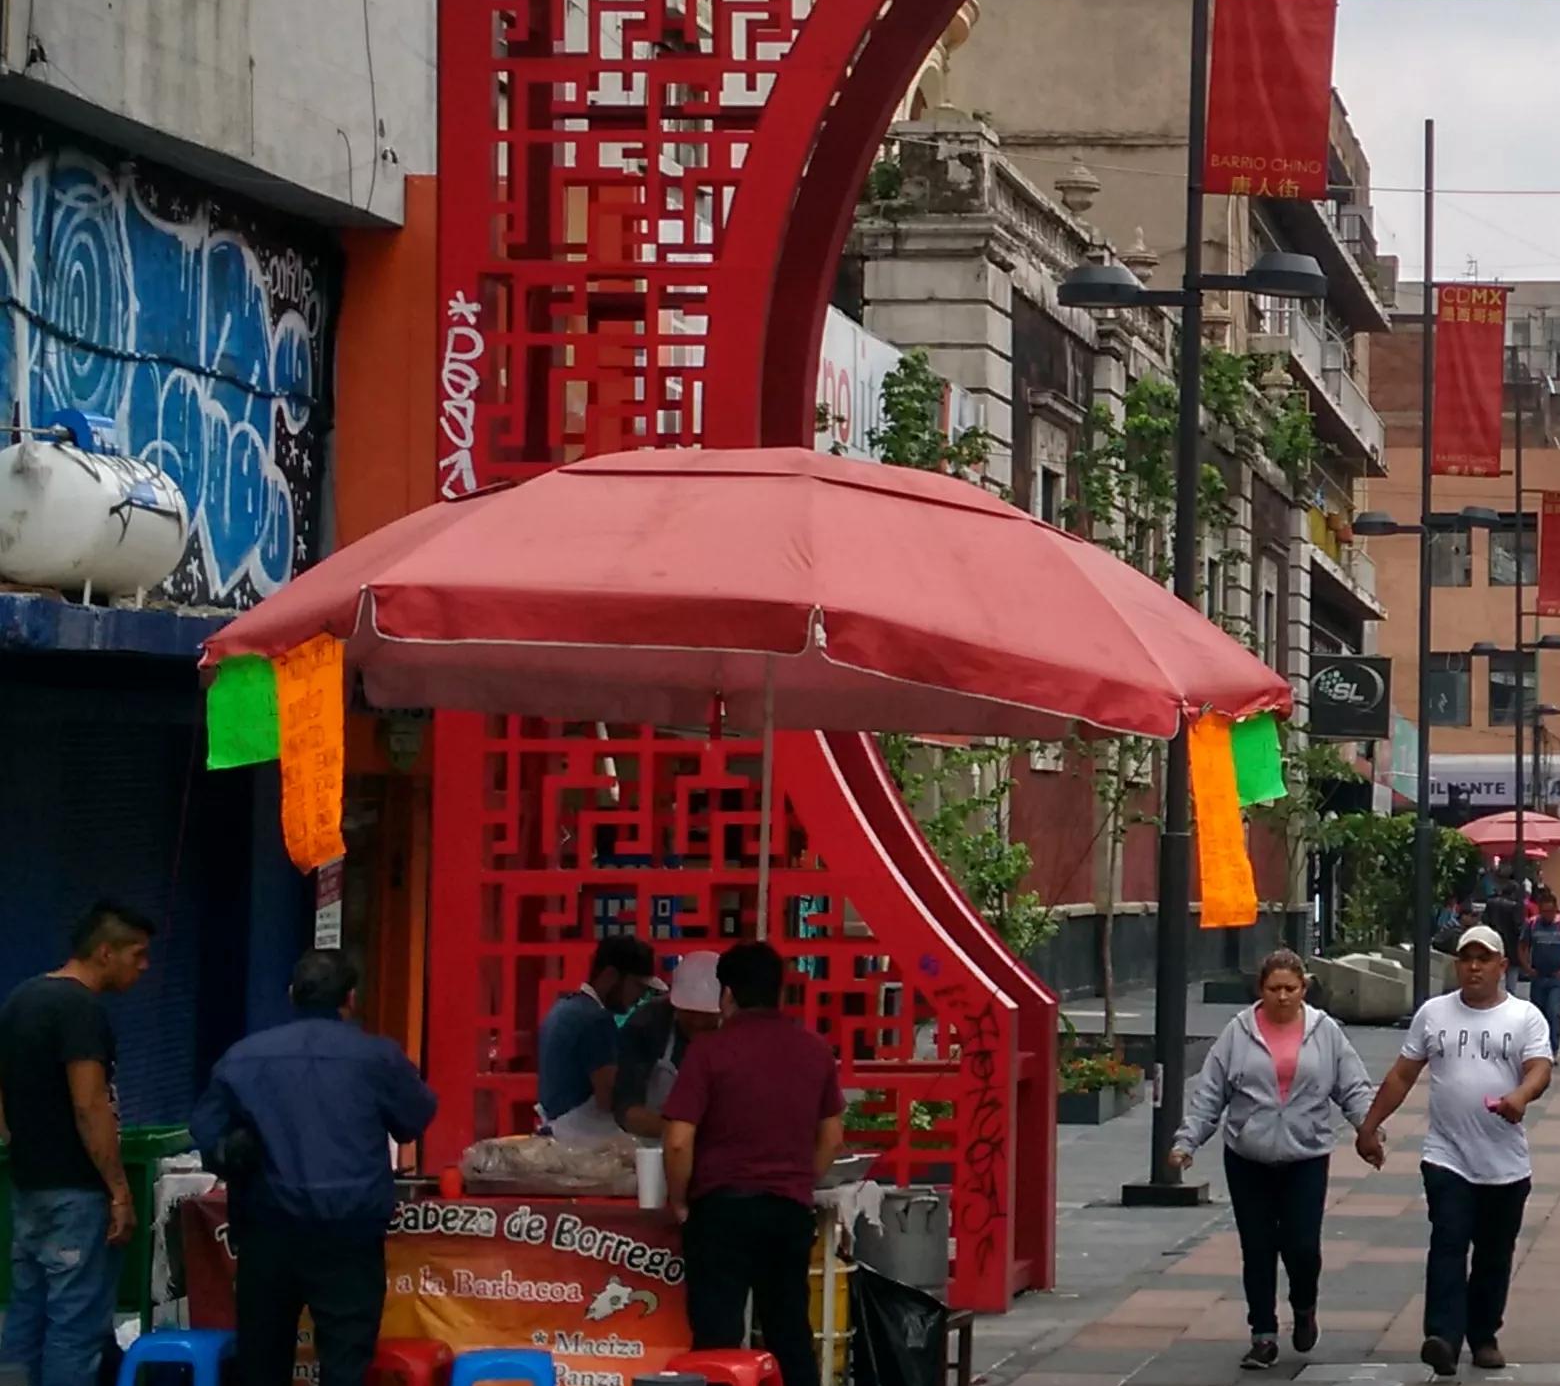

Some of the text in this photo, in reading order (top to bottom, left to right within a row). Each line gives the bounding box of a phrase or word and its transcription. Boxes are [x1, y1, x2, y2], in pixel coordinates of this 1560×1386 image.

[1211, 154, 1321, 174] BARRIO CHINO
[1442, 286, 1502, 305] CDMX
[1331, 682, 1365, 701] SL
[504, 1206, 548, 1245] de
[552, 1213, 685, 1286] Borrego
[453, 1268, 584, 1303] Barbacoa
[553, 1331, 645, 1358] Maciza
